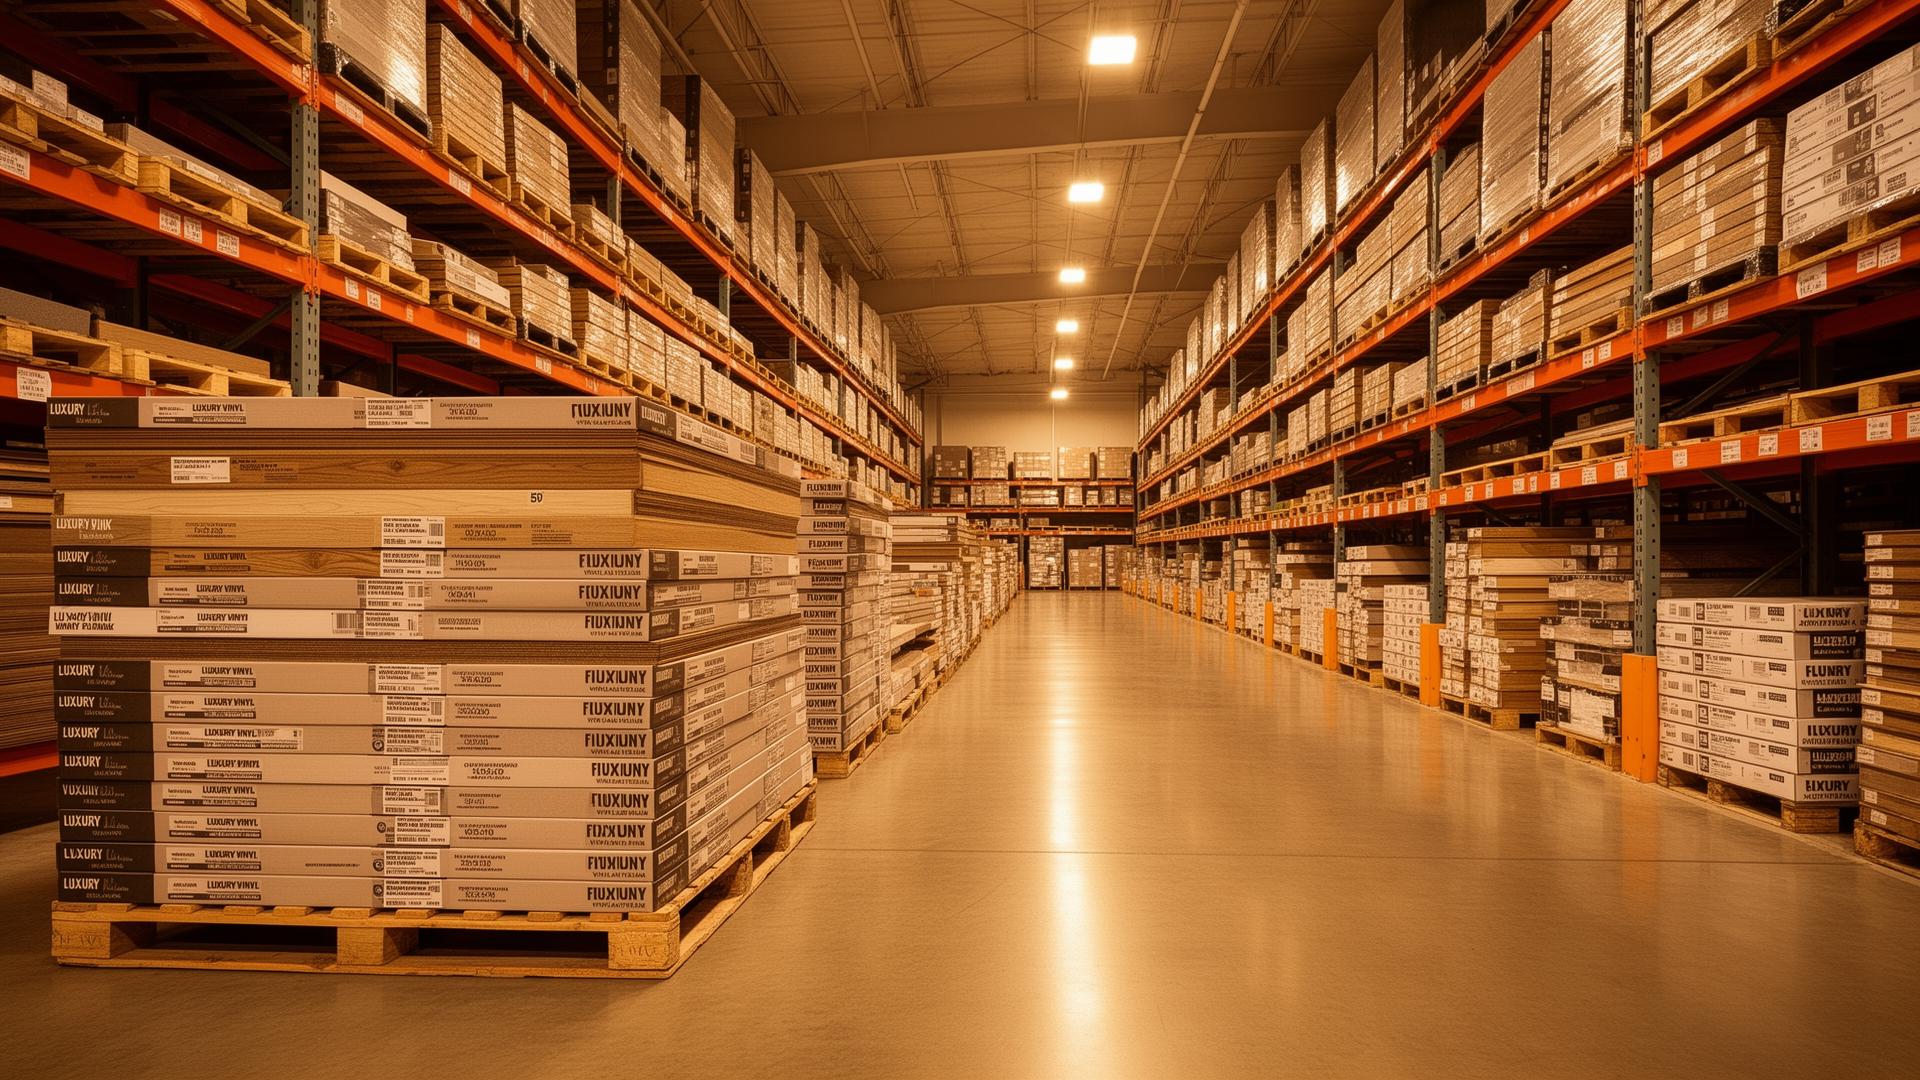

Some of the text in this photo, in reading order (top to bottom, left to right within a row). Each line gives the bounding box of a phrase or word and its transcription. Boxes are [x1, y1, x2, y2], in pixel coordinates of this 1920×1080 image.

[50, 403, 84, 414] LUXURY
[59, 584, 94, 595] LUXURY
[59, 665, 94, 676] LUXURY
[232, 667, 253, 675] VINYL
[59, 697, 94, 707] LUXURY
[204, 698, 233, 706] LUXURY
[63, 727, 99, 738] LUXURY
[65, 756, 101, 767] LUXURY
[203, 786, 255, 794] LUXURY VINYL
[64, 816, 101, 827] LUXURY
[207, 818, 258, 826] LUXURY VINYL
[64, 878, 99, 889] LUXURY
[207, 881, 259, 889] LUXURY VINYL
